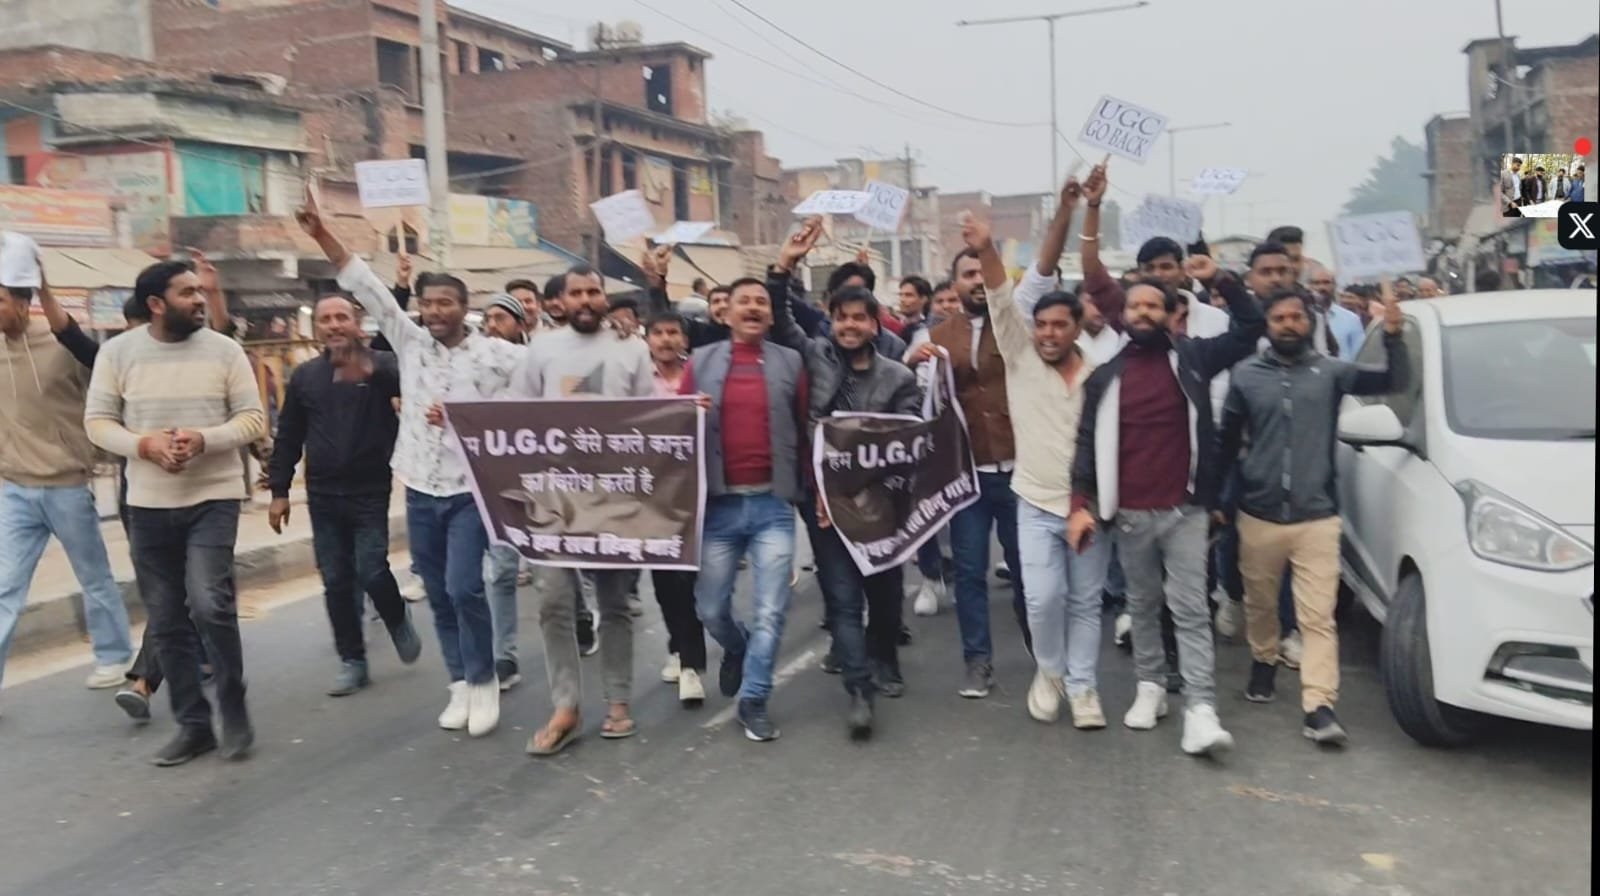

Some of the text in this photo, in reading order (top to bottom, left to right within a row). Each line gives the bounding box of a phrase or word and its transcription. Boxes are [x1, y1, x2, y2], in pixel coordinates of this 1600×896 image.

[1100, 100, 1161, 135] UGC
[1086, 119, 1149, 157] GO BACK
[484, 428, 567, 457] U.G.C
[571, 427, 602, 454] जैसे
[604, 428, 645, 454] काले
[647, 434, 695, 461] कानून
[519, 472, 544, 493] का
[550, 467, 594, 493] विरोध
